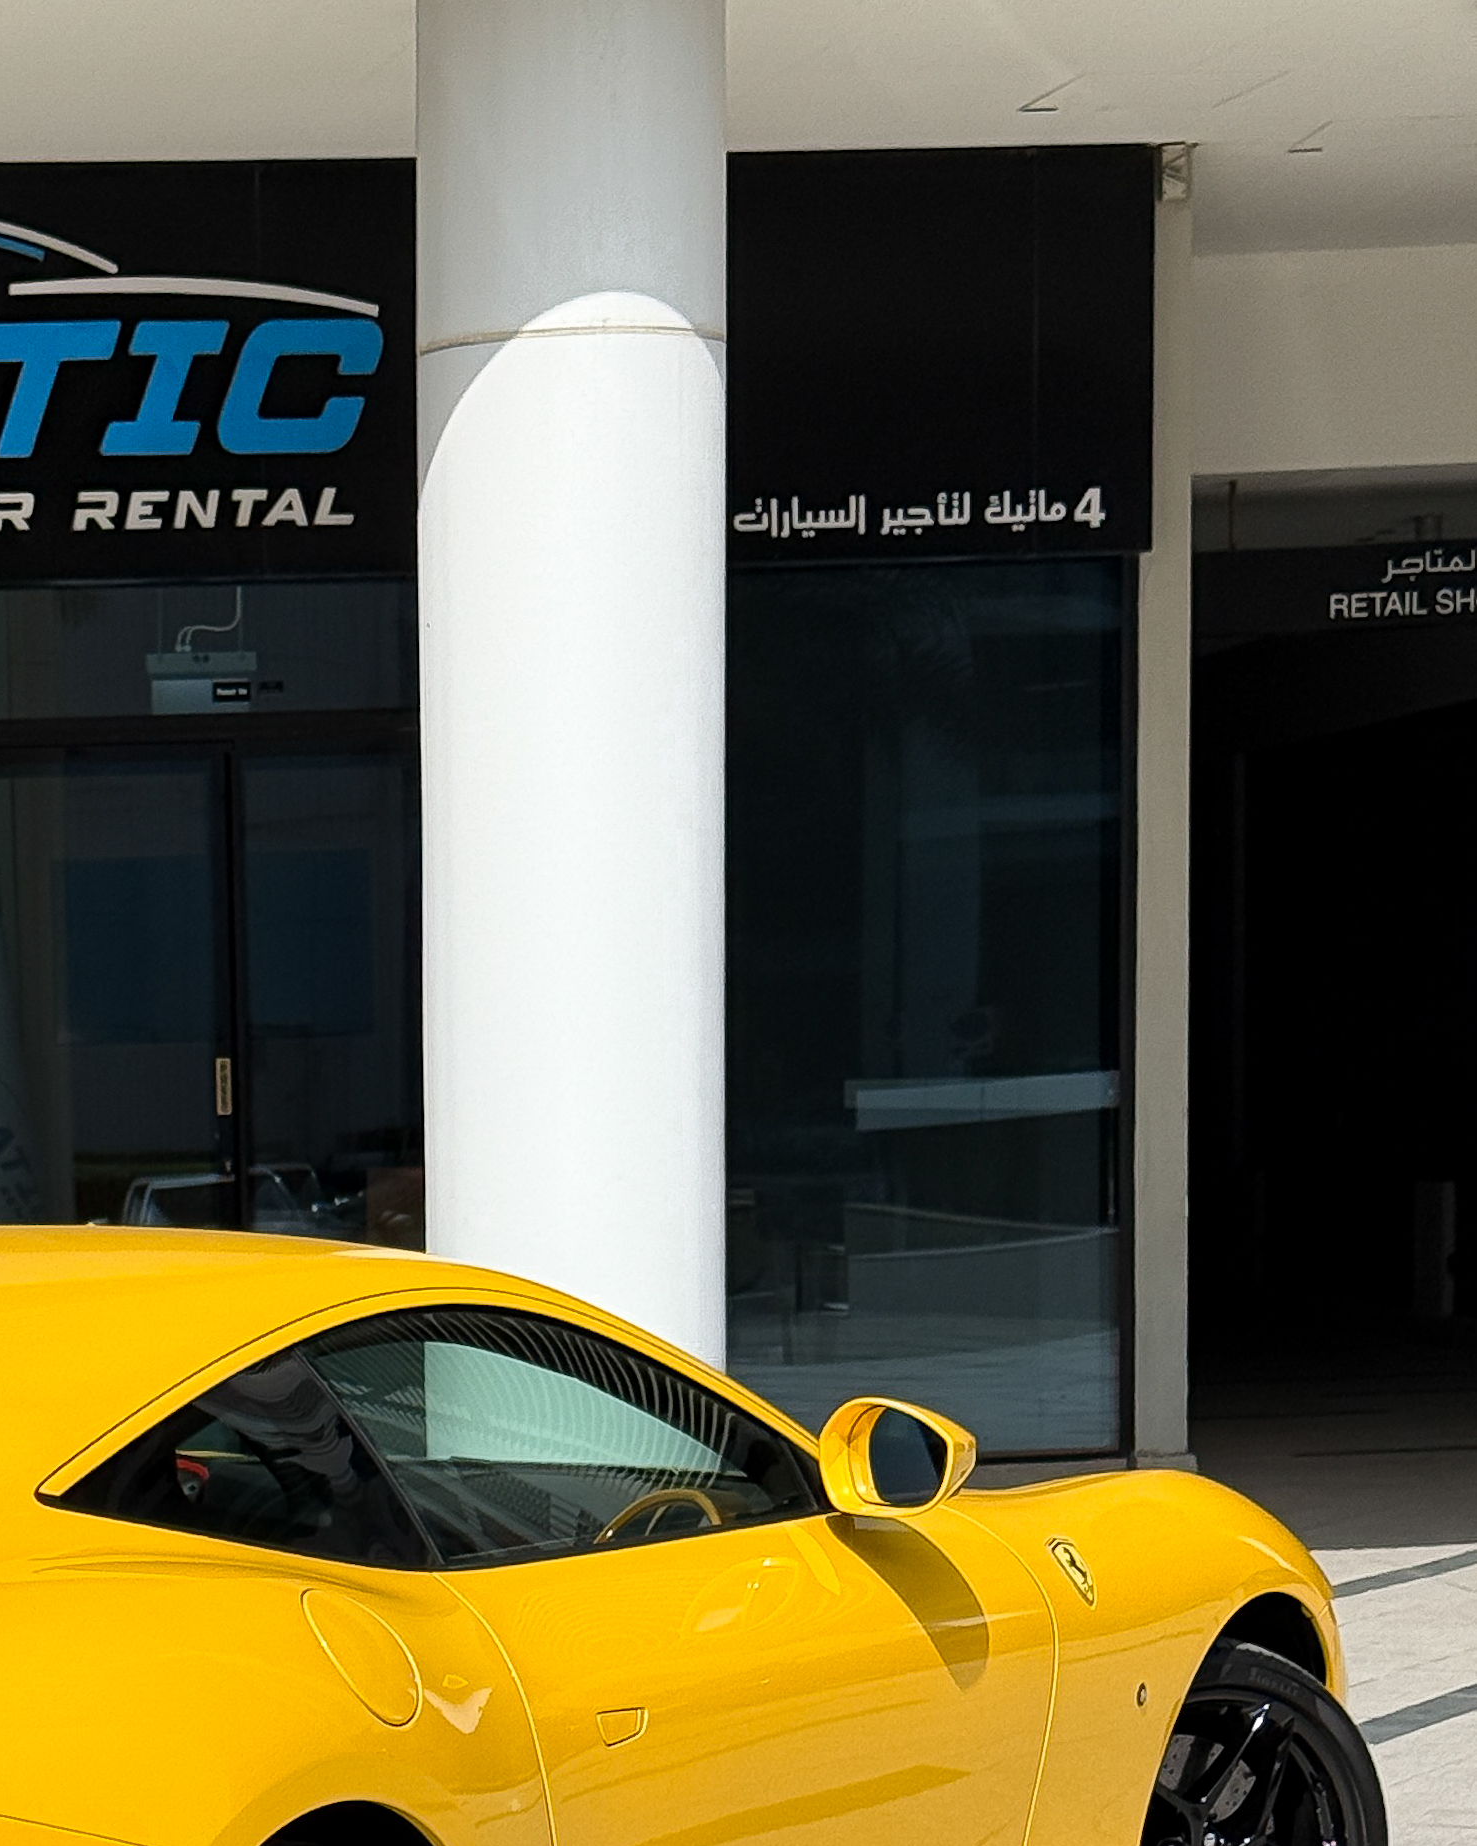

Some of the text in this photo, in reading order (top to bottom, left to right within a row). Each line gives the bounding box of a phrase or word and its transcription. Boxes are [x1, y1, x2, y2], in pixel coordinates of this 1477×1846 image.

[73, 486, 355, 532] RENTAL
[732, 485, 1107, 539] 4 ماتيك لتأجير السيارات
[1380, 548, 1477, 584] لمتاجر
[1328, 587, 1477, 620] RETAIL SH
